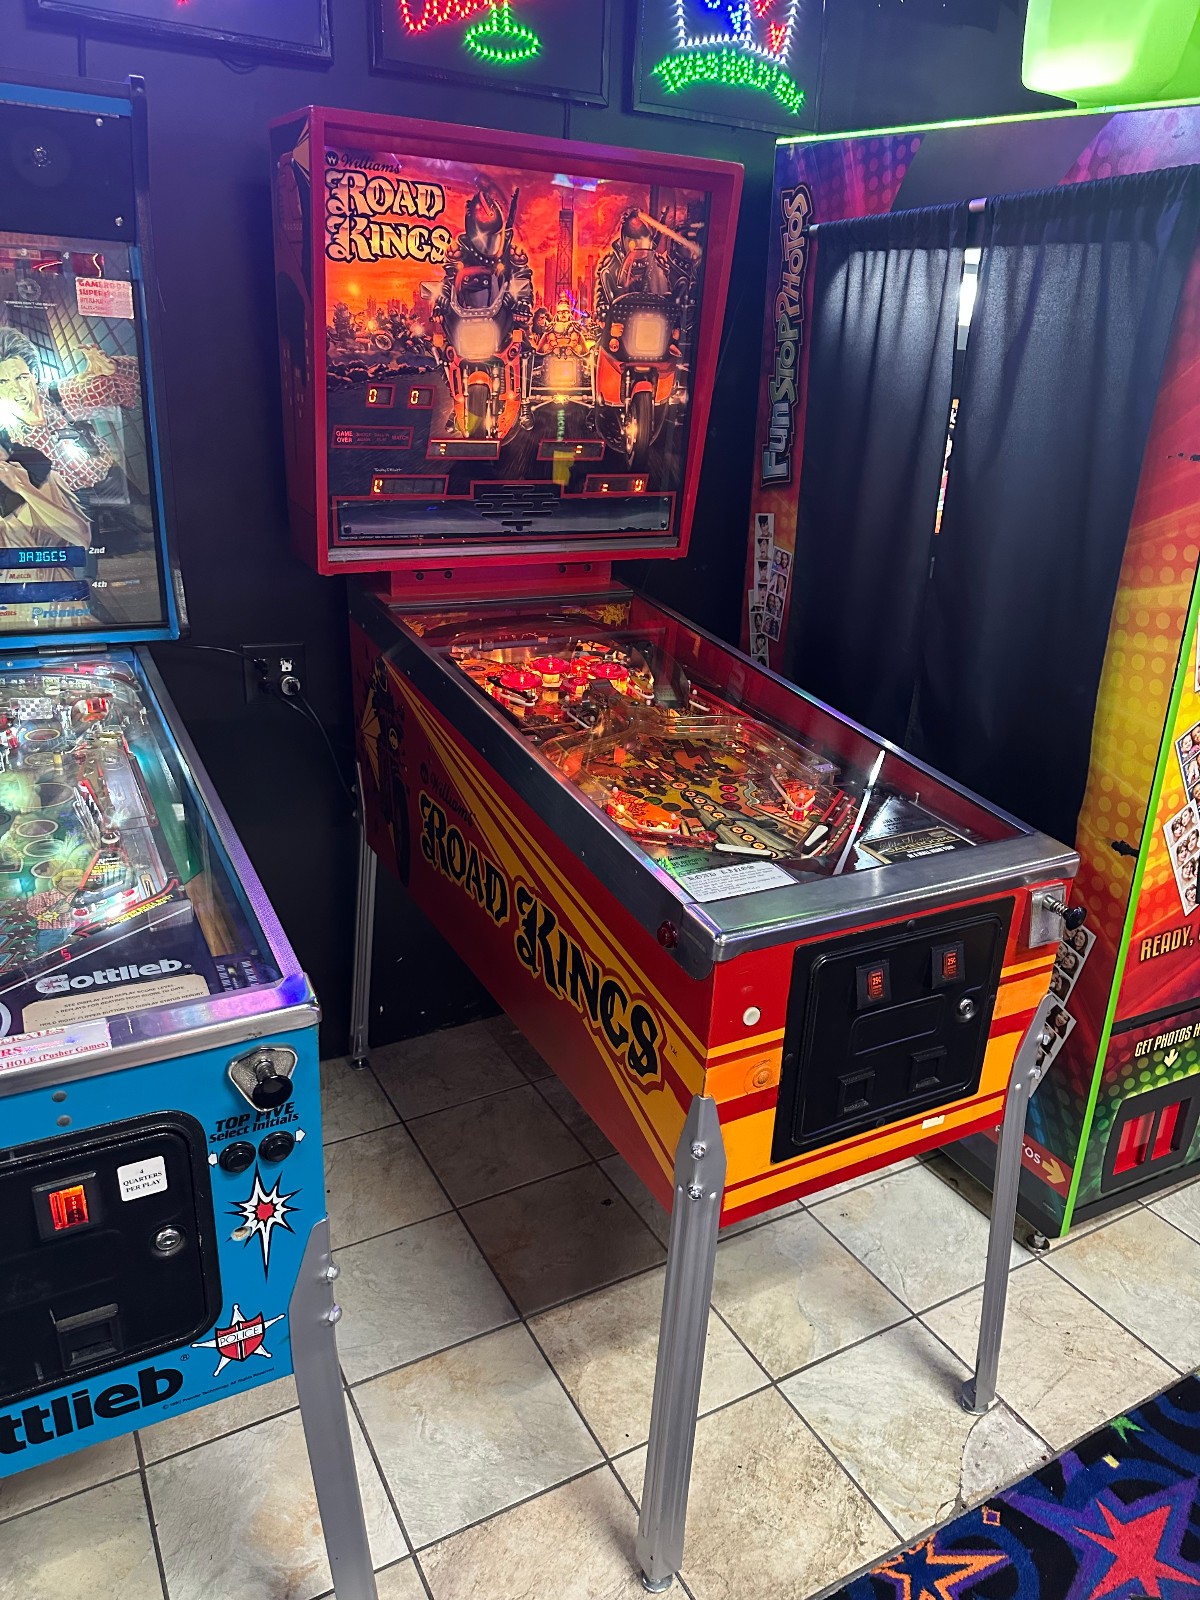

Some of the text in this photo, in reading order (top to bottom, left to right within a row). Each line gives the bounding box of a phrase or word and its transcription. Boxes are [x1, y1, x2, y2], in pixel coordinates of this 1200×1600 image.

[342, 153, 400, 174] Williams
[325, 168, 445, 221] ROAD
[325, 215, 452, 264] KINGS
[63, 252, 70, 260] 4
[18, 551, 66, 563] BADGES
[88, 546, 106, 554] 2nd
[92, 580, 108, 588] 4th
[430, 771, 474, 828] Williams
[418, 789, 511, 928] ROAD
[513, 880, 662, 1086] KINGS
[1140, 925, 1193, 962] READY,
[60, 1005, 86, 1013] REPLAYS
[1134, 1038, 1154, 1057] GET
[1154, 1025, 1192, 1050] PHOTOS
[6, 1057, 36, 1068] HOLE
[40, 1048, 73, 1062] (Pusher
[76, 1041, 109, 1053] Games)
[209, 1112, 300, 1144] Select Initials
[216, 1102, 295, 1132] TOP FIVE
[123, 1172, 162, 1186] QUARTERS
[126, 1178, 161, 1192] PER PLAY
[220, 1326, 260, 1346] POLICE
